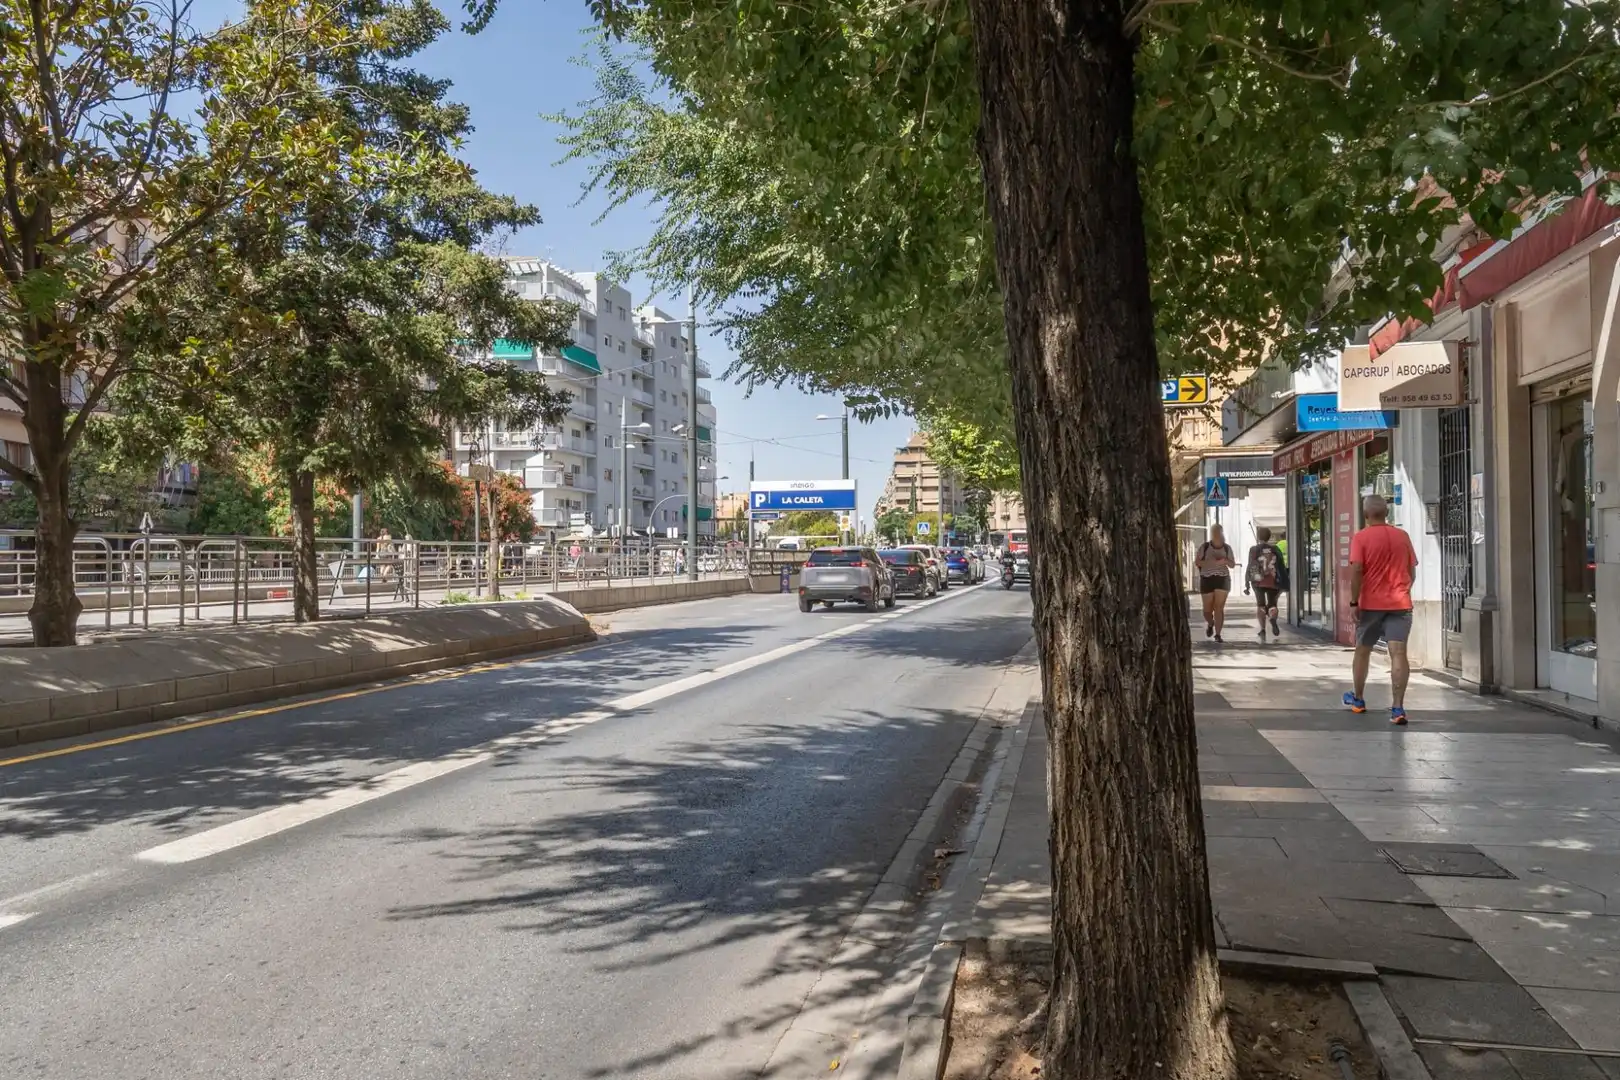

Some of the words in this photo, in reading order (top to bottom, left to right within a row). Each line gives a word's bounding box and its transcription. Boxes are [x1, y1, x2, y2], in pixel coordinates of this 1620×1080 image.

[1343, 366, 1390, 379] CAPGRUP
[1397, 363, 1452, 377] ABOGADOS
[1443, 393, 1453, 401] 53
[1307, 405, 1337, 415] Reyes
[755, 493, 766, 507] P
[781, 496, 793, 504] LA
[794, 496, 824, 504] CALETA
